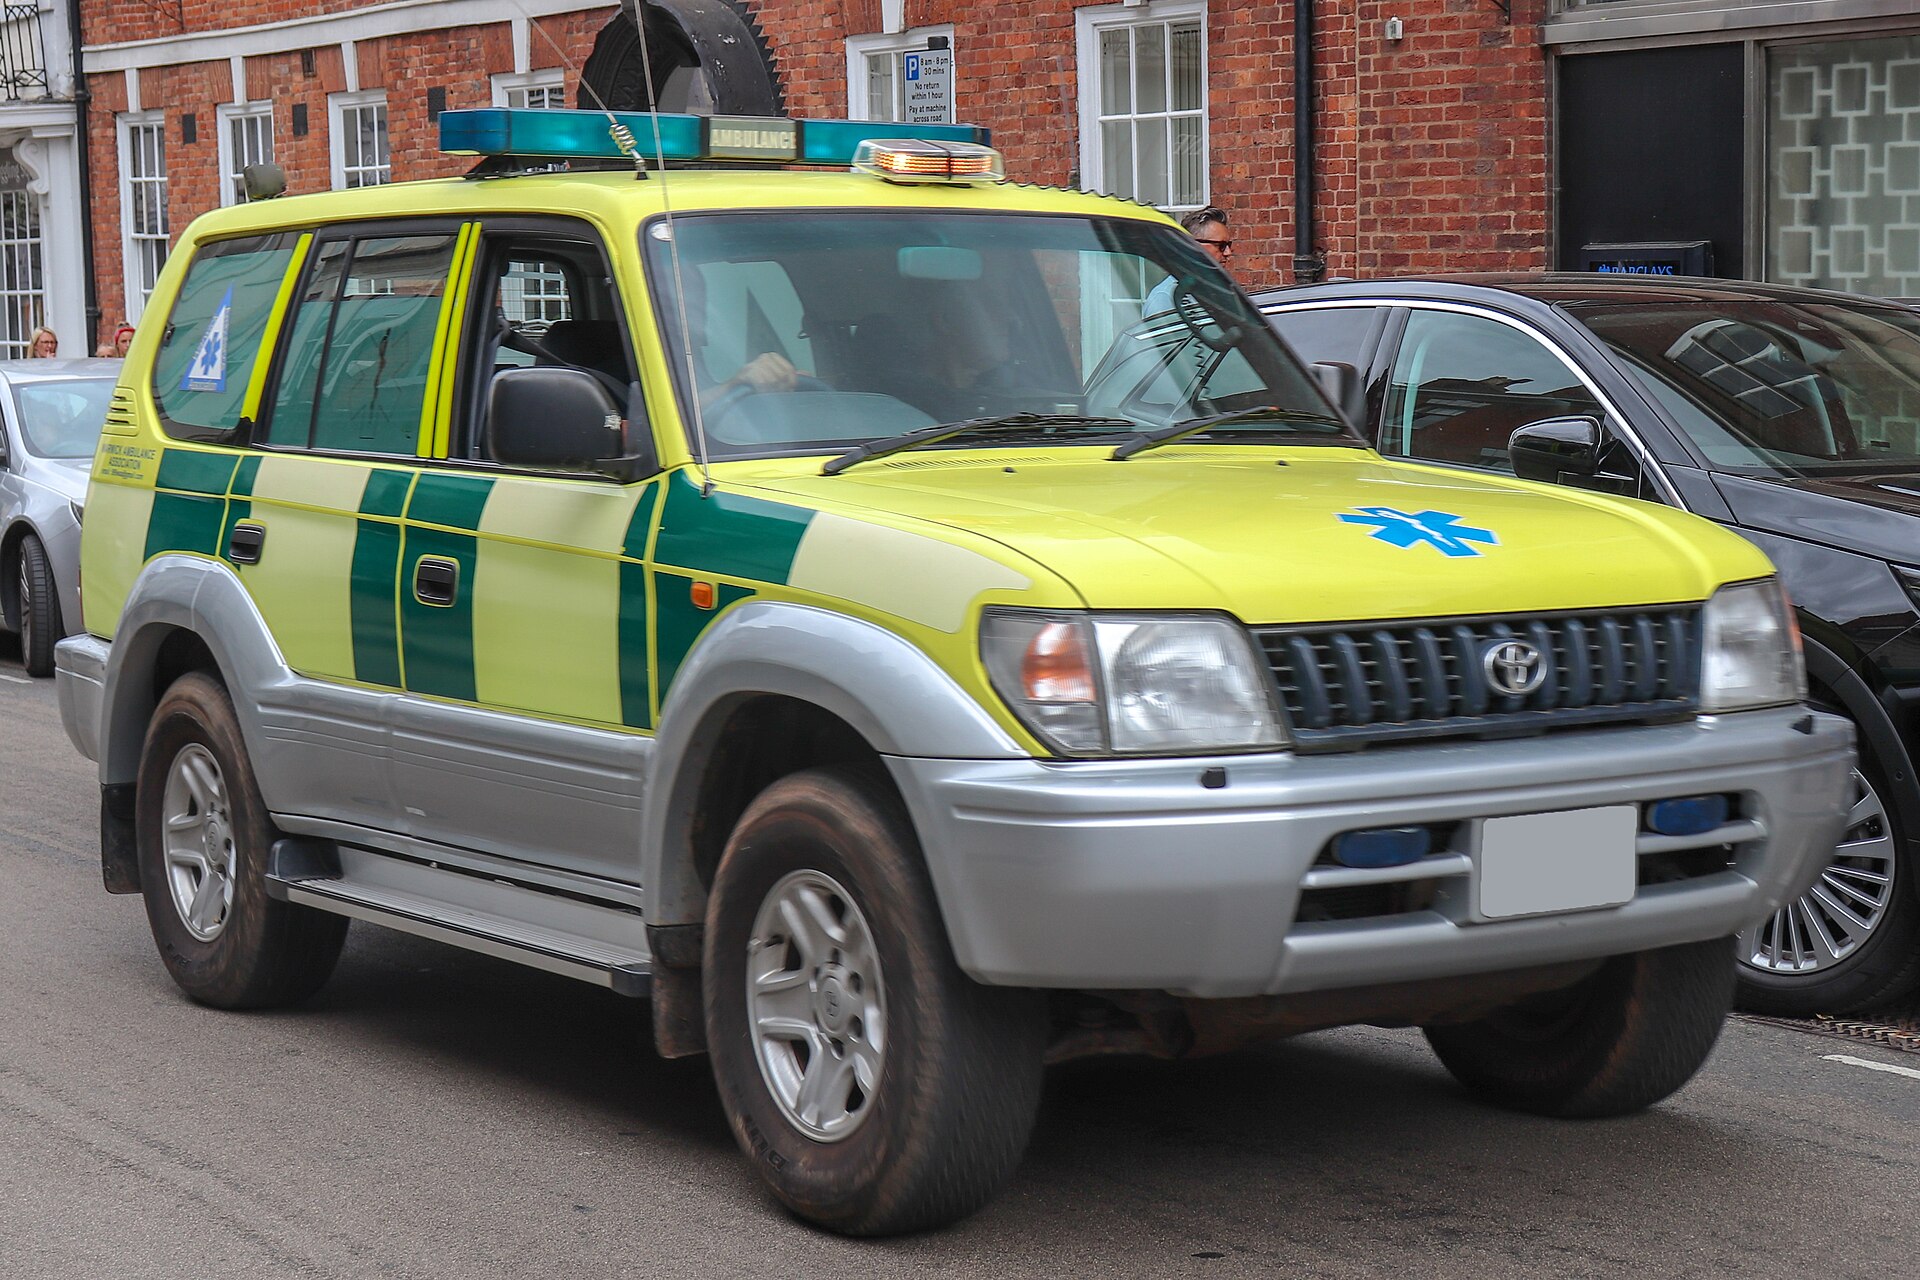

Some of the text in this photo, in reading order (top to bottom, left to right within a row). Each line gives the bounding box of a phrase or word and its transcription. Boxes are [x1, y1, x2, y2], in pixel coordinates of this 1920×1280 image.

[908, 57, 917, 79] P
[924, 67, 944, 75] 30 mins
[915, 82, 922, 90] No
[912, 92, 927, 100] within
[931, 91, 943, 99] hour
[909, 105, 918, 114] Pay
[925, 104, 946, 112] machine
[930, 114, 942, 122] road
[709, 129, 797, 149] AMBULANCE
